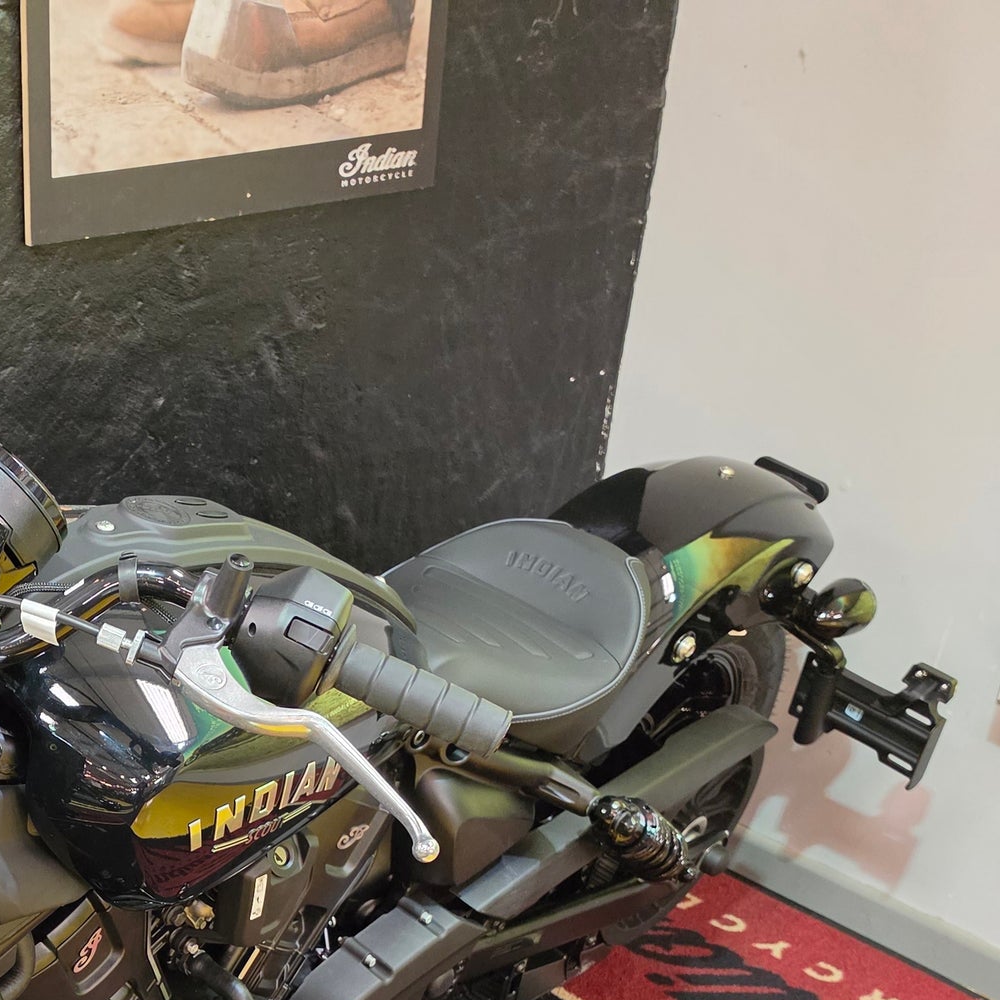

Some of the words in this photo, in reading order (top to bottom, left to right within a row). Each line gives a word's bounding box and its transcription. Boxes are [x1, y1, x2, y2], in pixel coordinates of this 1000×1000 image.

[338, 142, 418, 178] Indian
[340, 169, 414, 187] MOTORCYCLE
[505, 551, 590, 603] INDIAN
[188, 756, 341, 853] INDIAN
[245, 814, 284, 846] SCOUT
